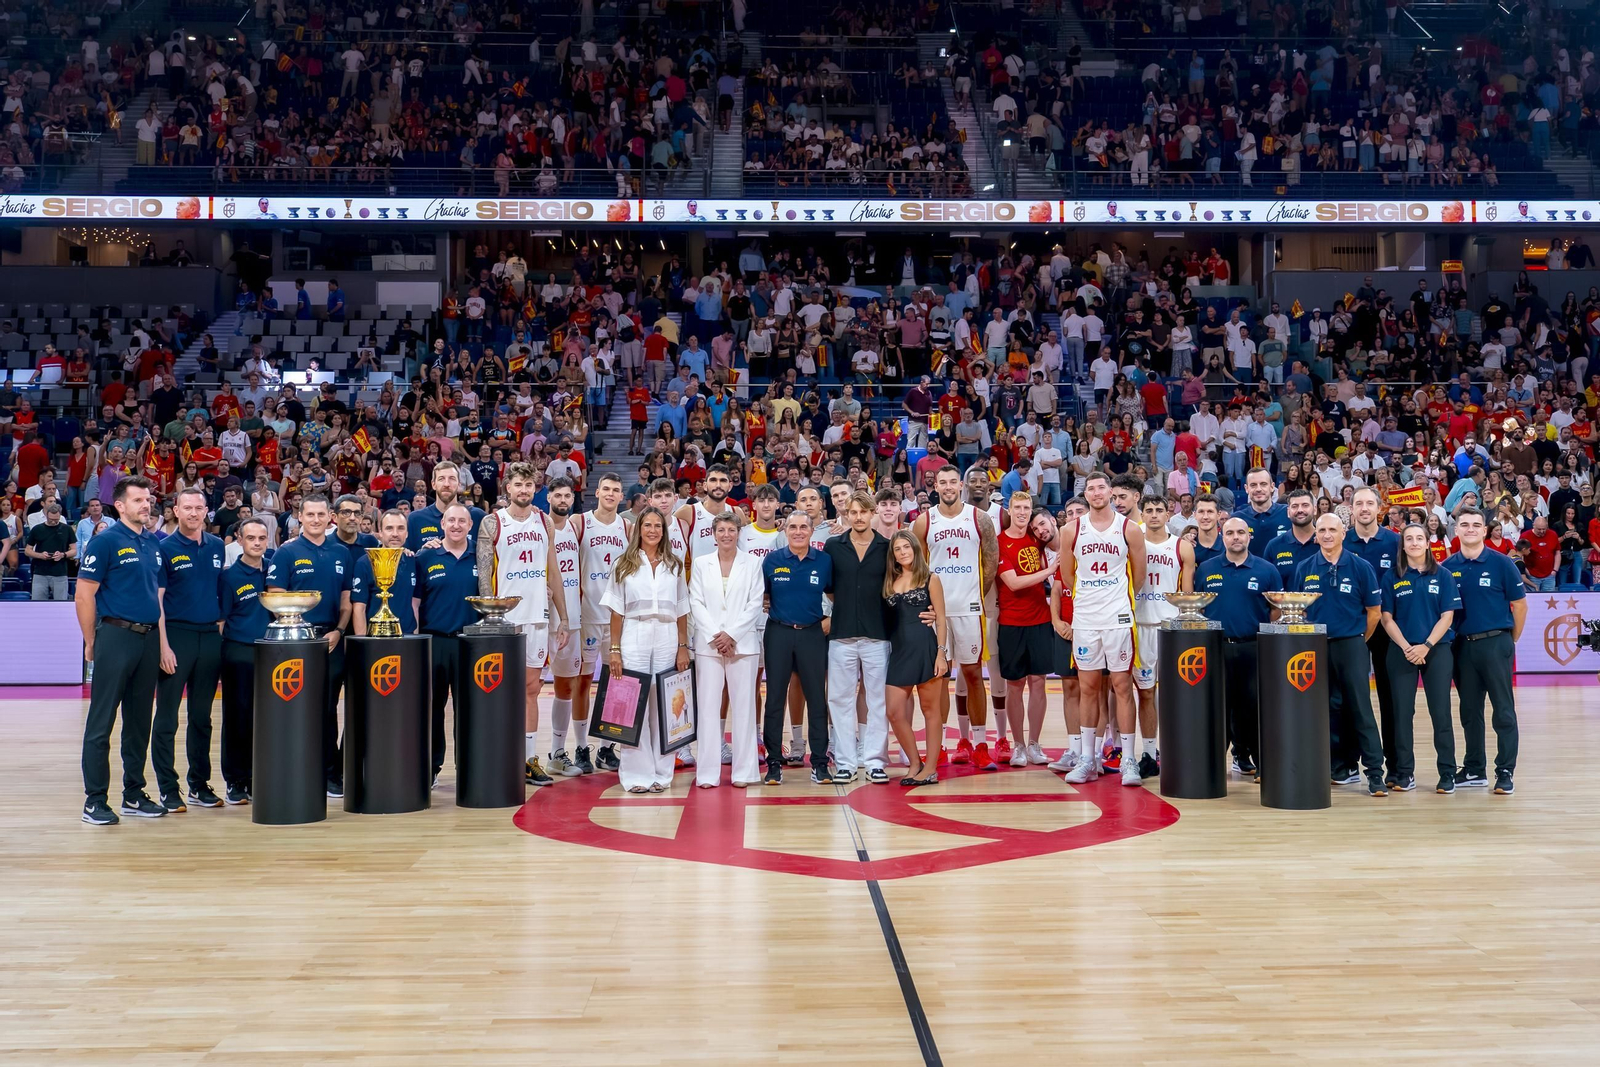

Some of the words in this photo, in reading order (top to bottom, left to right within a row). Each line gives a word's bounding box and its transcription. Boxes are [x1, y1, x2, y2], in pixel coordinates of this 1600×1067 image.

[42, 198, 163, 216] SERGIO
[424, 199, 470, 220] Gracias
[475, 201, 594, 220] SERGIO
[850, 200, 894, 222] Gracias
[900, 202, 1016, 221] SERGIO
[1266, 201, 1310, 222] Gracias
[1315, 203, 1429, 221] SERGIO
[1393, 492, 1420, 504] ESPAÑA
[506, 530, 544, 546] ESPAÑA
[590, 535, 624, 550] ESPAÑA
[934, 528, 971, 543] ESPAÑA
[518, 550, 533, 564] 41
[947, 546, 960, 559] 14
[1082, 542, 1120, 557] ESPAÑA
[560, 559, 574, 573] 22
[604, 552, 611, 566] 4
[1147, 554, 1174, 569] PAÑA
[934, 565, 972, 574] endesa
[1090, 562, 1108, 574] 44
[1148, 572, 1160, 586] 11
